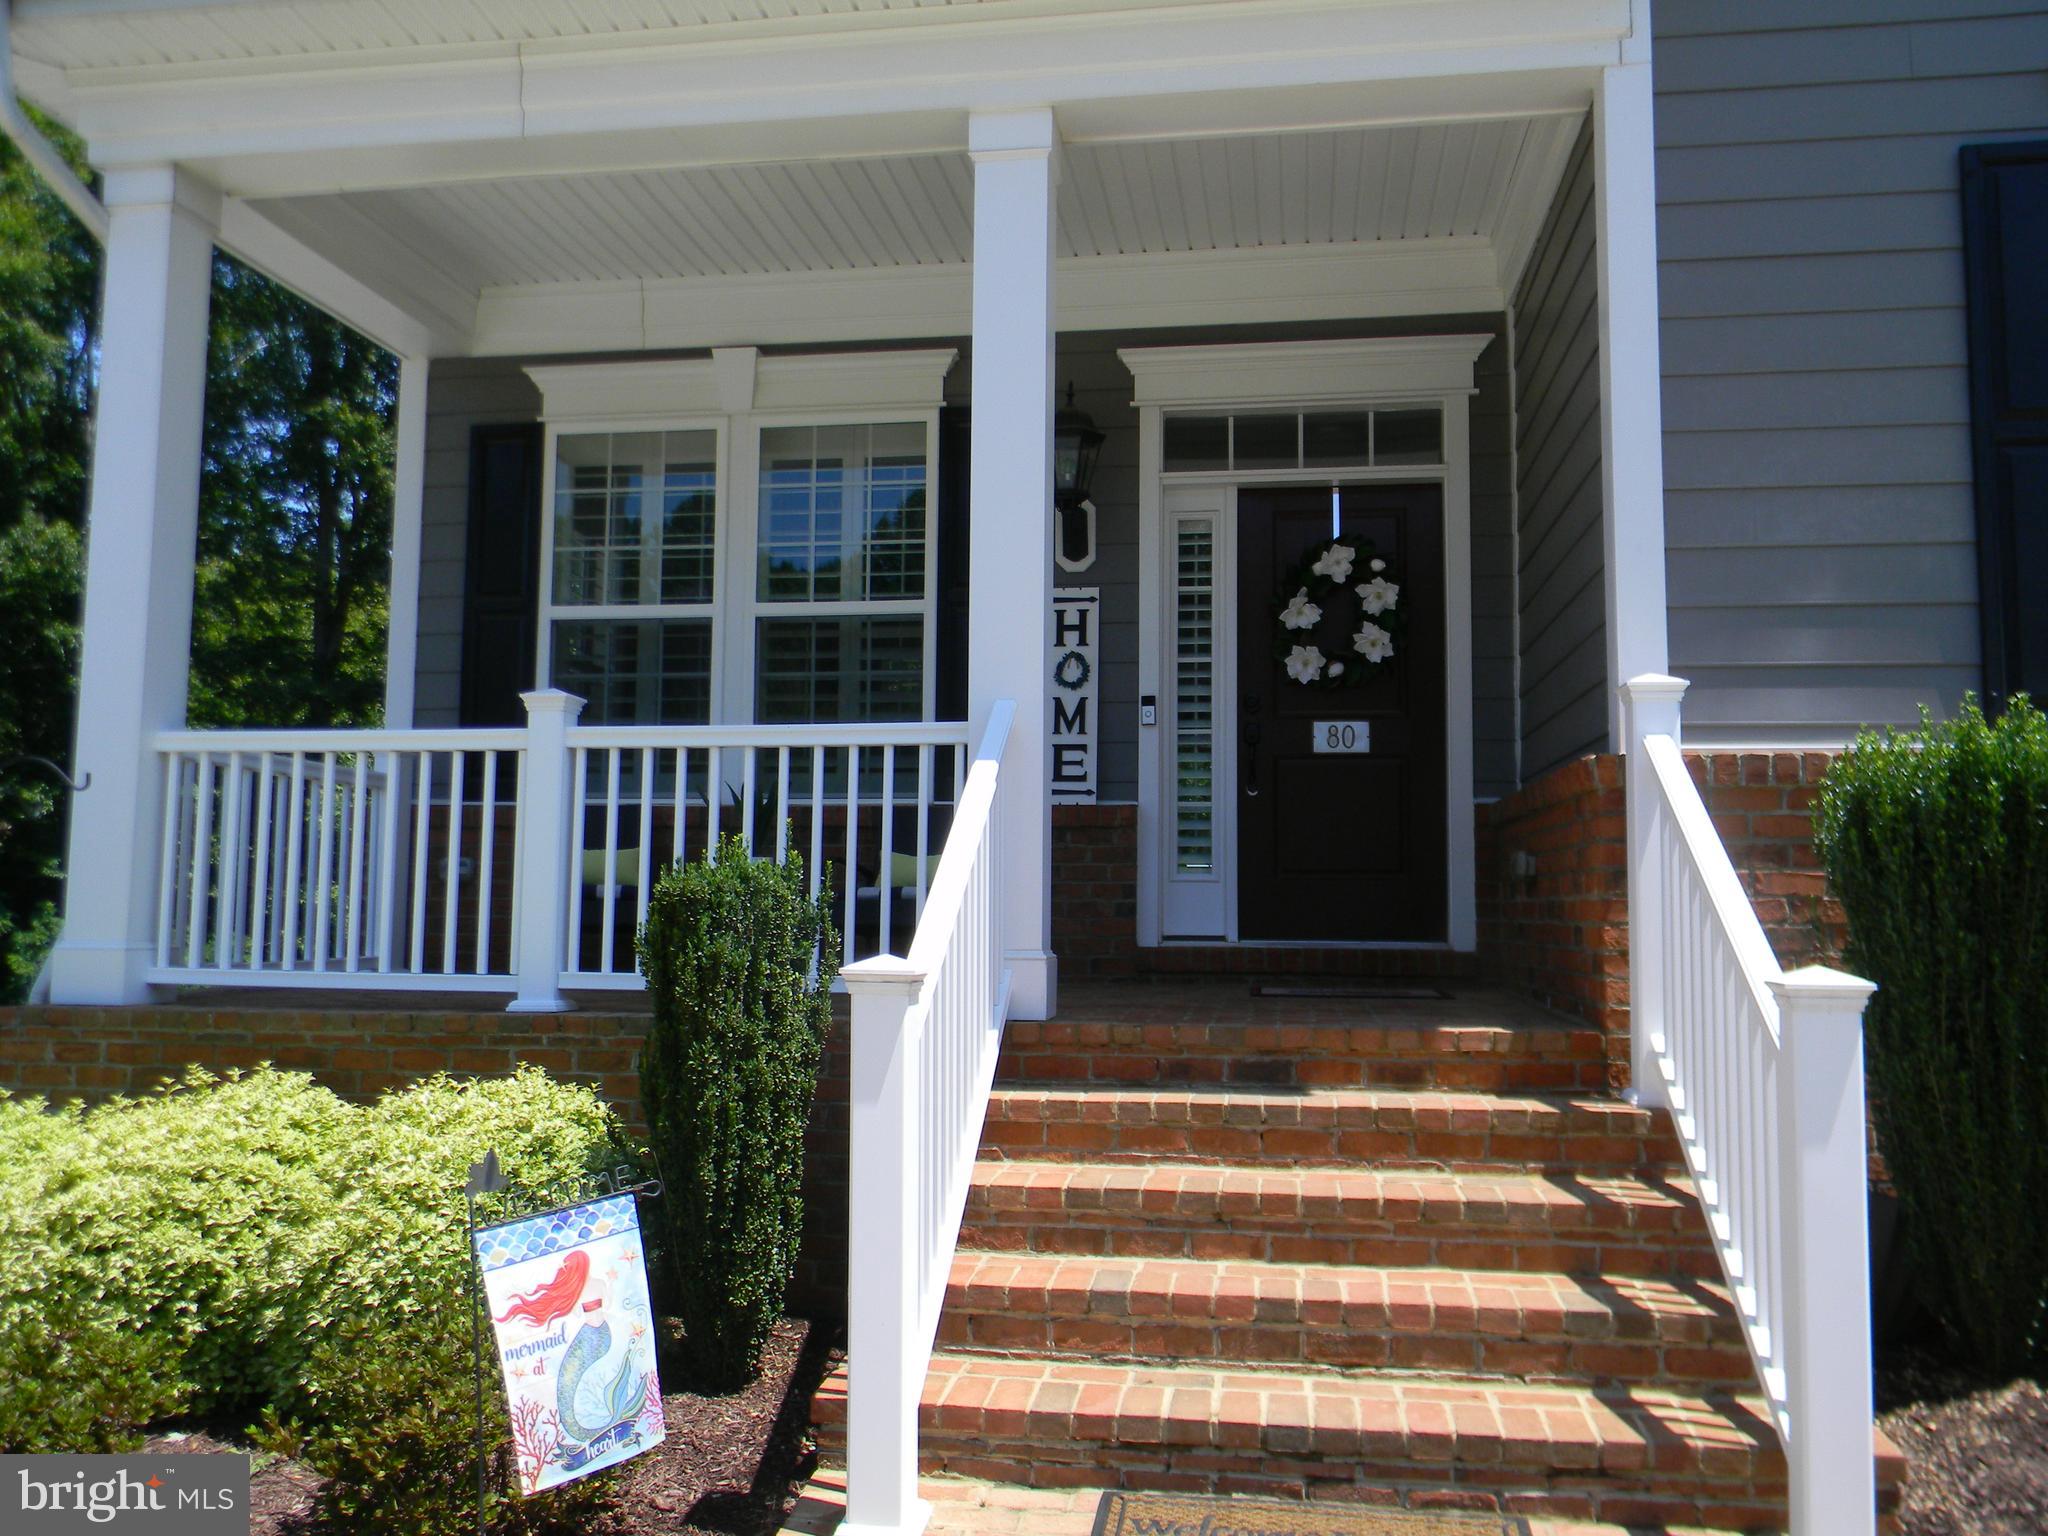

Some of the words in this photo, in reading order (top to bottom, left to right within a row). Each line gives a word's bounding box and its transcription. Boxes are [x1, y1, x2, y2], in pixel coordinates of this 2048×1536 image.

[1051, 609, 1090, 783] HOME
[1327, 725, 1355, 749] 80
[504, 1321, 568, 1362] mermaid
[533, 1356, 551, 1376] at
[585, 1427, 622, 1460] heart
